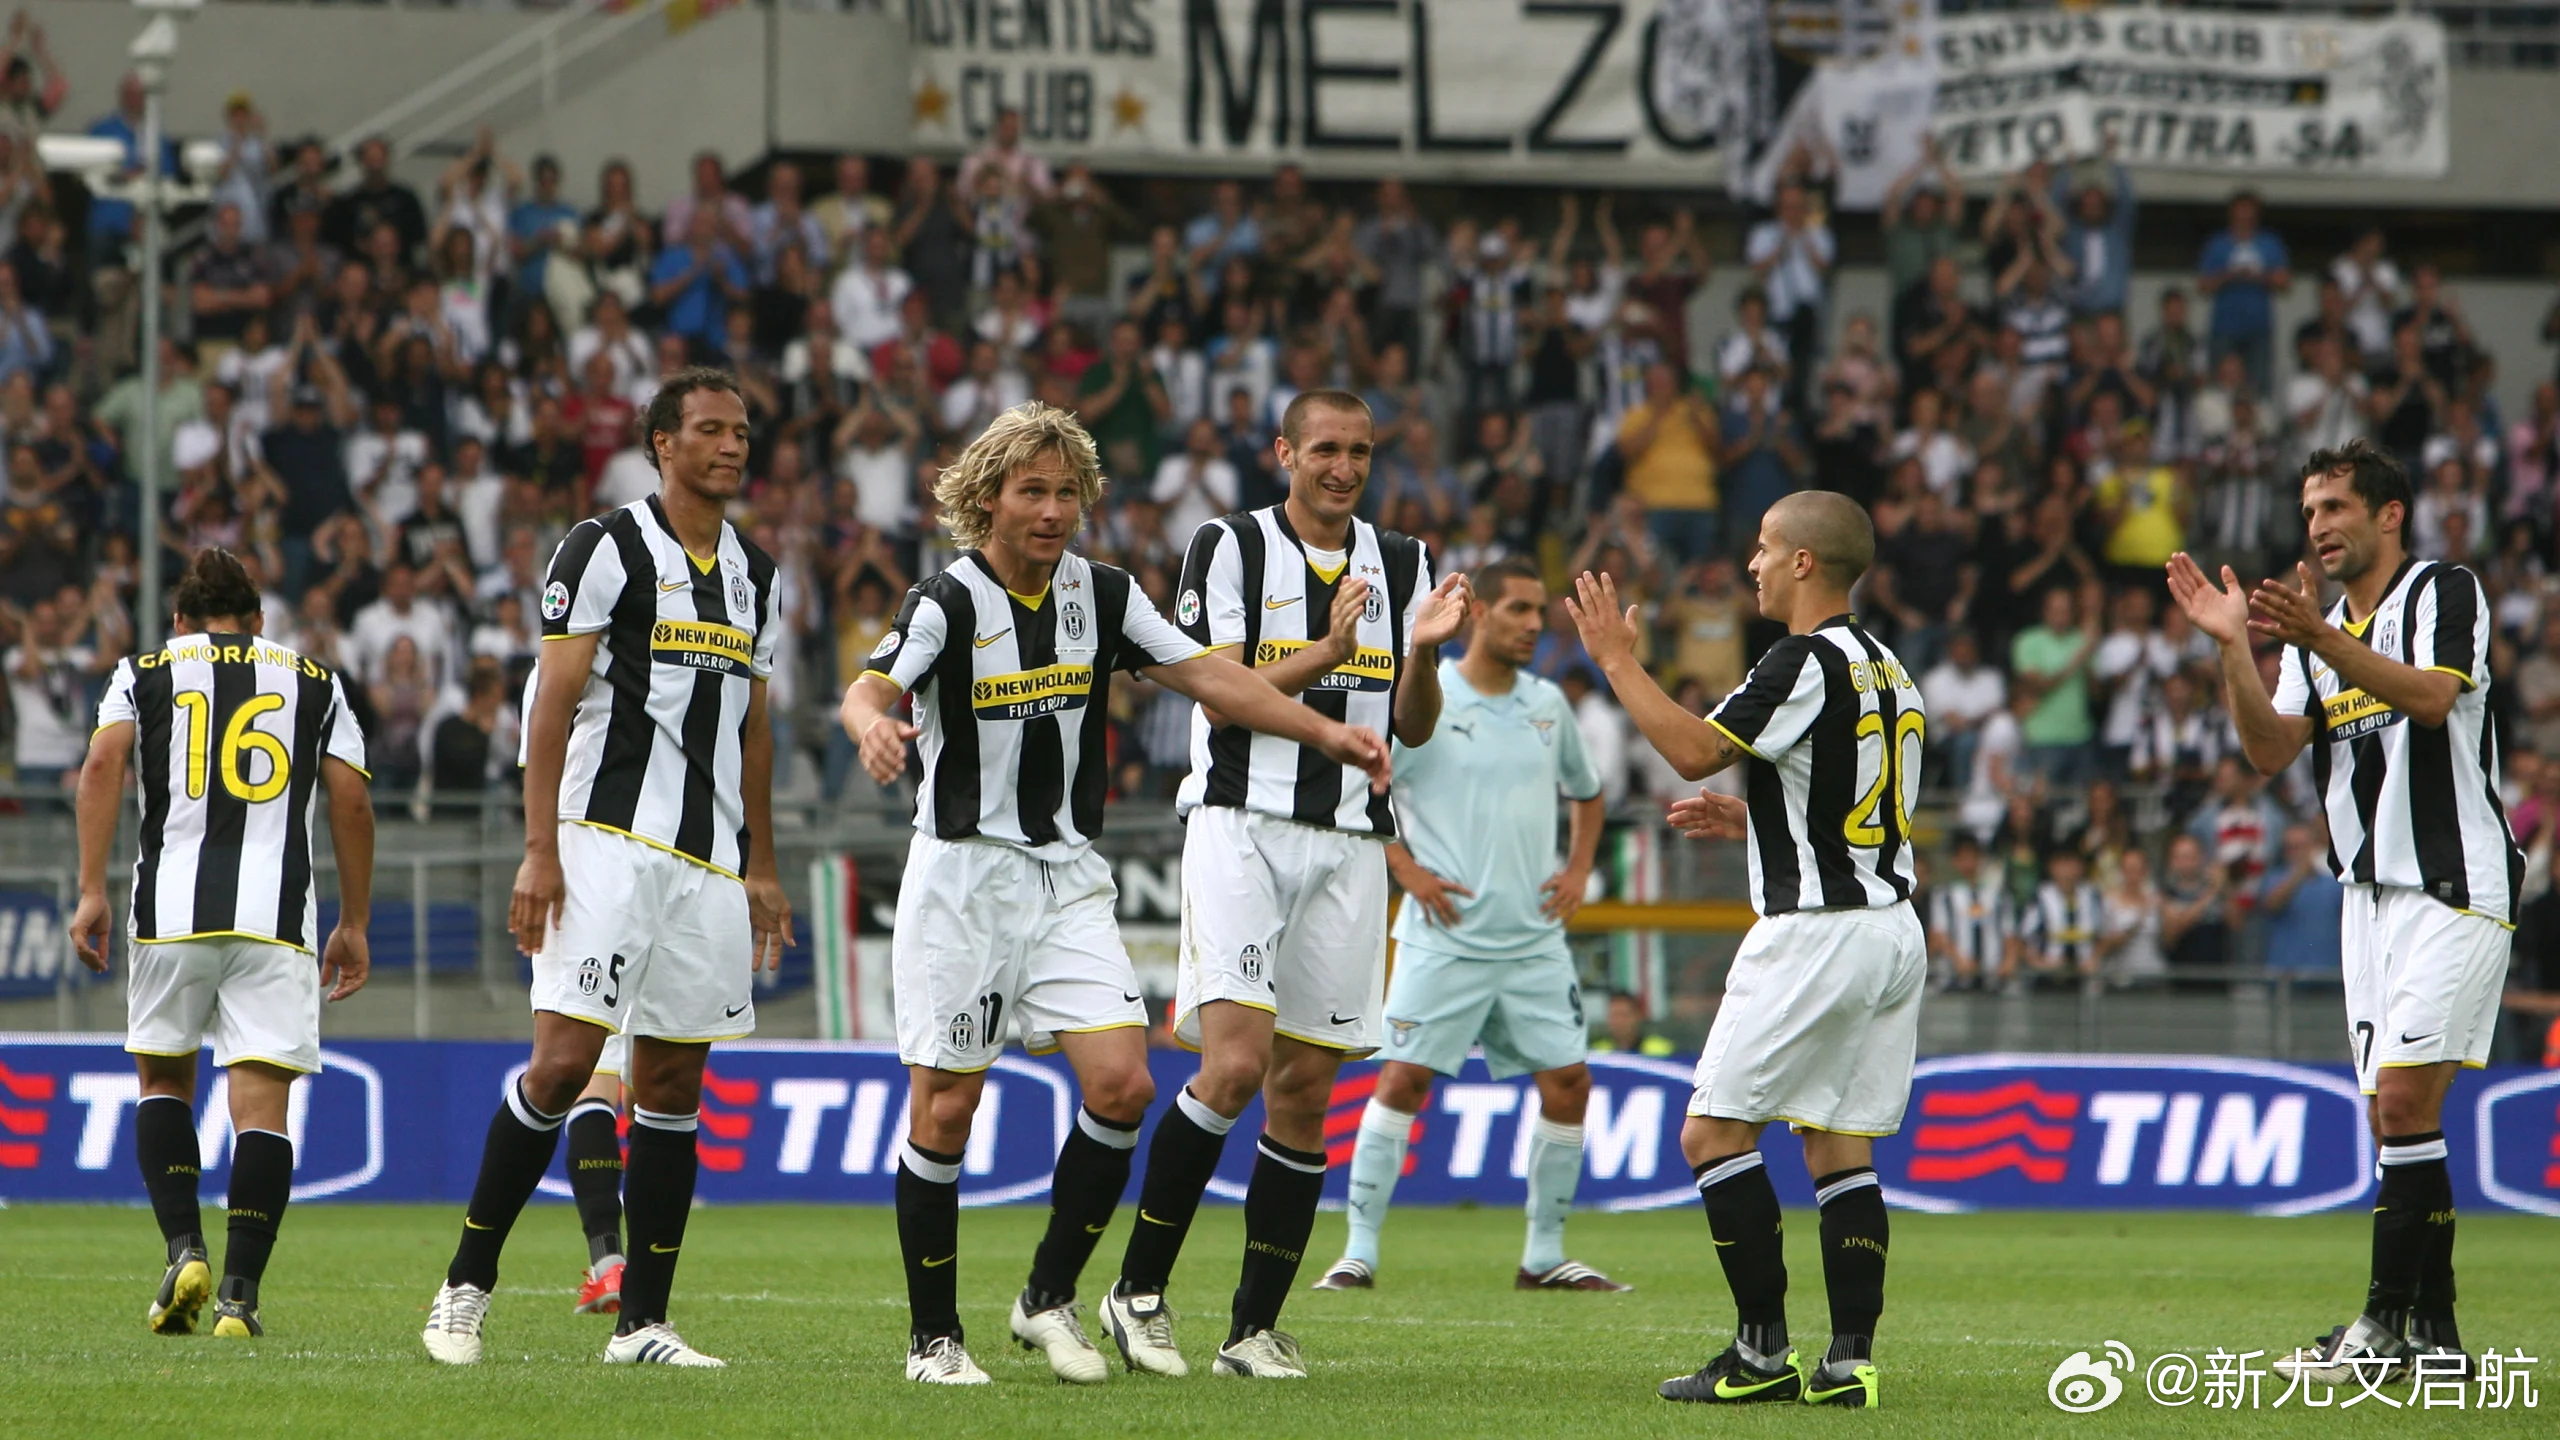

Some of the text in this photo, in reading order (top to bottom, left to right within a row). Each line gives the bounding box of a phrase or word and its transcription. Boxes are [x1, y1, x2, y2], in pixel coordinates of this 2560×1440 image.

[2123, 21, 2261, 61] CLUB
[961, 64, 1093, 141] CLUB
[675, 628, 706, 645] NEW
[995, 678, 1034, 697] NEW
[1320, 674, 1362, 689] GROUP
[1008, 702, 1035, 718] FIAT
[2325, 700, 2350, 719] NEW
[174, 690, 291, 804] 16
[2336, 722, 2356, 740] FIAT
[1843, 708, 1925, 849] 20
[603, 953, 626, 1008] 5
[2356, 1021, 2375, 1074] 7
[1441, 1084, 1665, 1179] TIM
[2089, 1091, 2308, 1187] TIM
[1247, 1240, 1299, 1262] JUVENTUS
